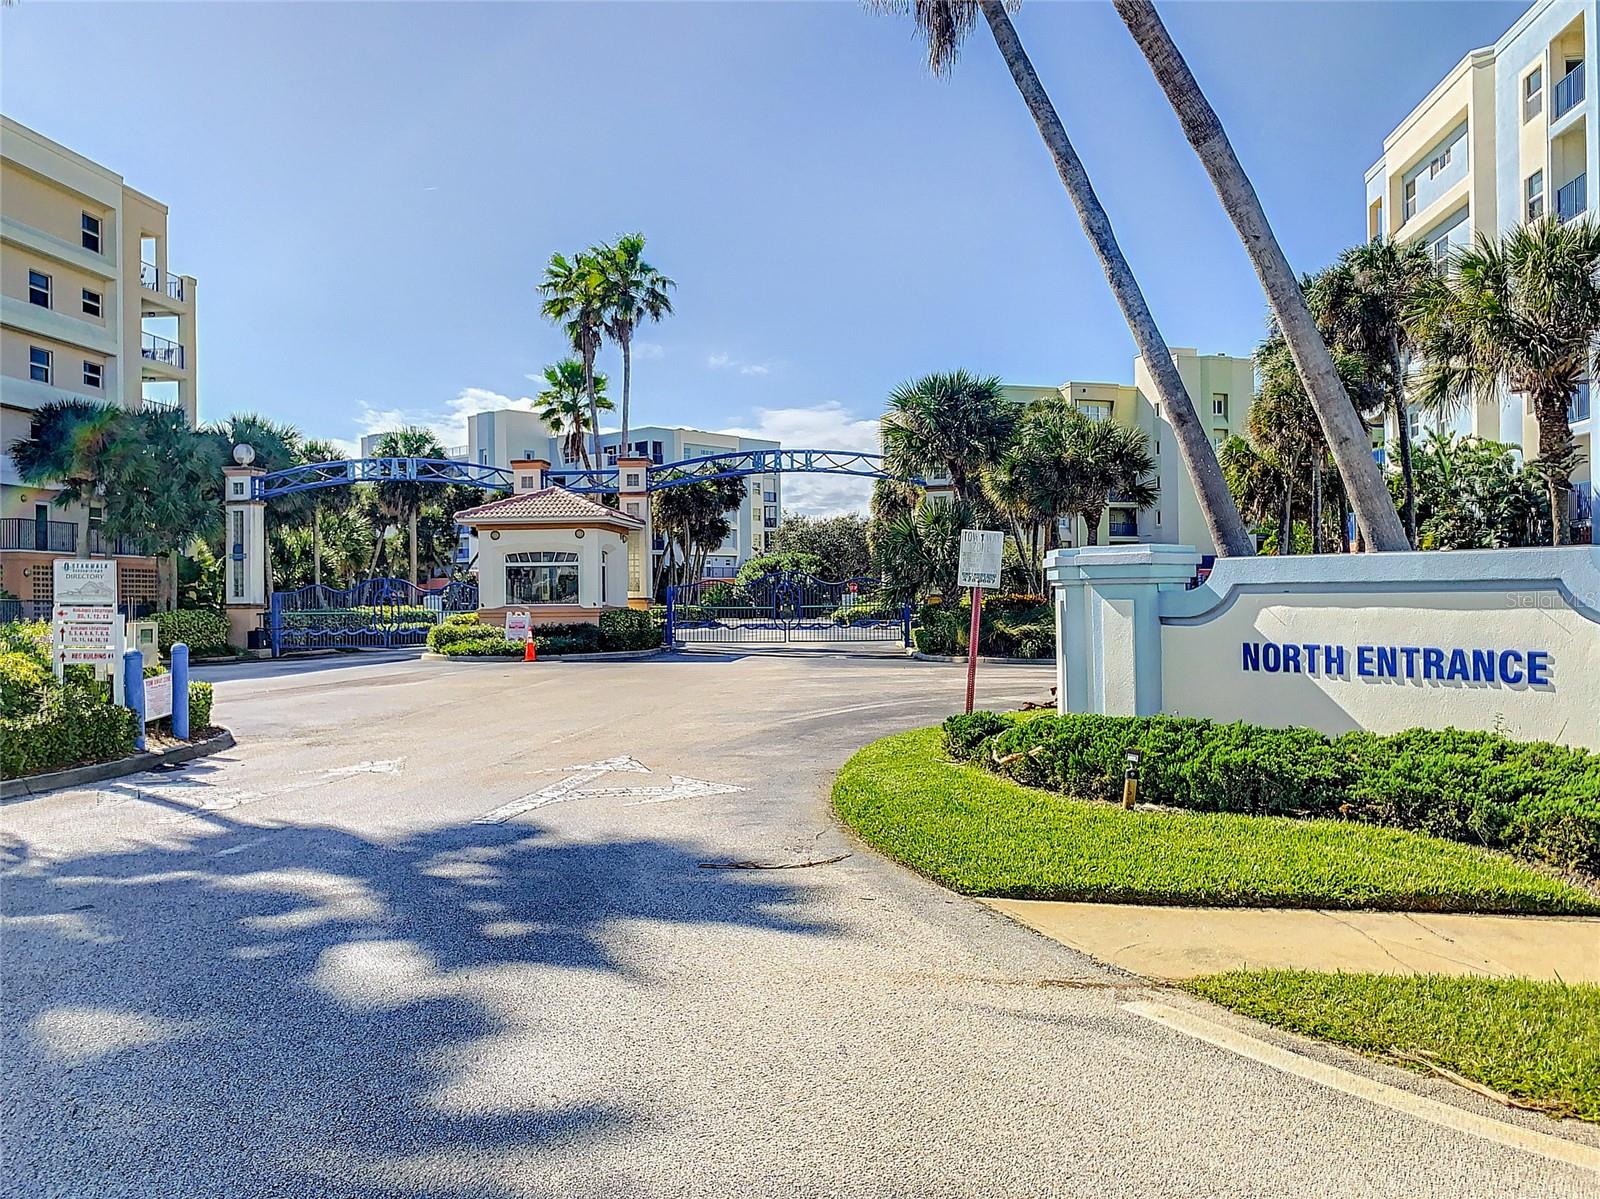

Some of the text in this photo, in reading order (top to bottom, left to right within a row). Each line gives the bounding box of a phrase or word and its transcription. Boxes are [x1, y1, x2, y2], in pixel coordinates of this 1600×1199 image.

[347, 458, 417, 481] OCEAN
[1241, 641, 1550, 686] NORTH ENTRANCE
